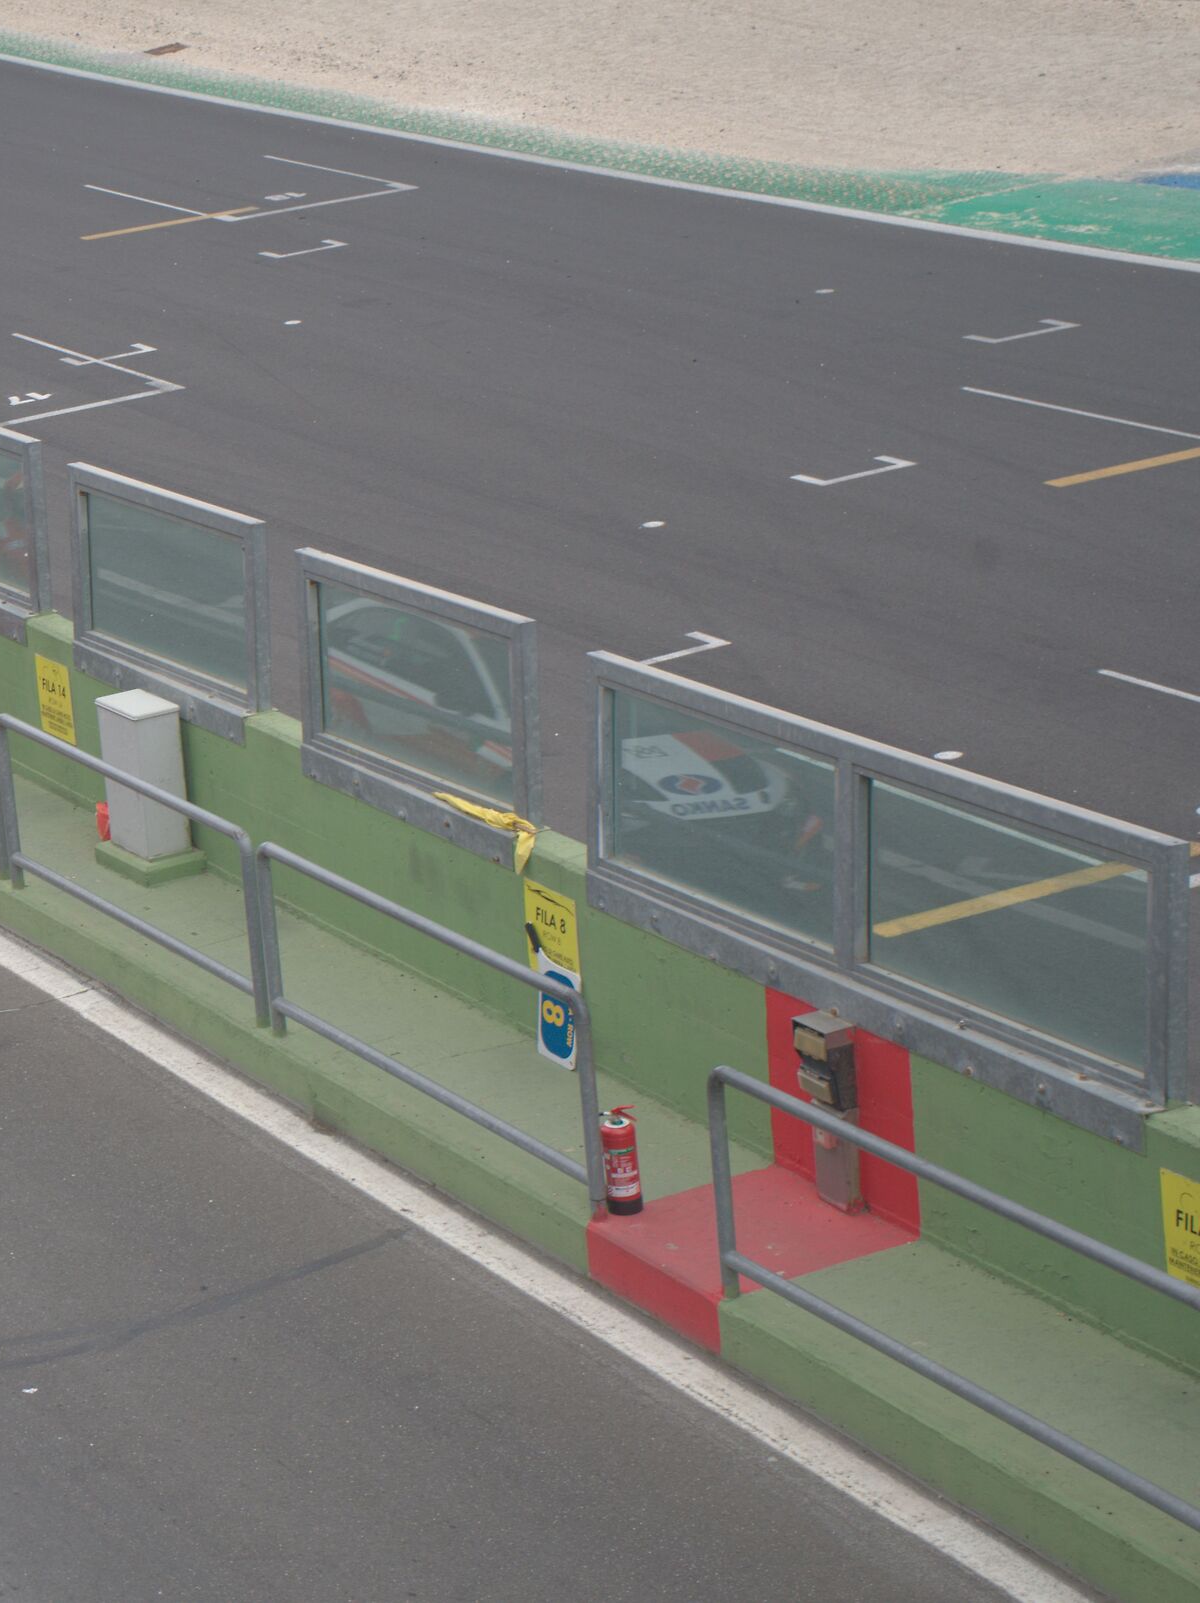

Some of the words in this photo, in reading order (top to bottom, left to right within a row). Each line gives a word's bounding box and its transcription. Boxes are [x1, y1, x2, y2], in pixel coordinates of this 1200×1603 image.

[42, 677, 56, 695] FILA
[536, 907, 557, 930] FILA
[560, 919, 566, 934] 8
[543, 1000, 565, 1027] 8
[566, 1023, 574, 1047] ROW
[1176, 1208, 1200, 1237] FIL
